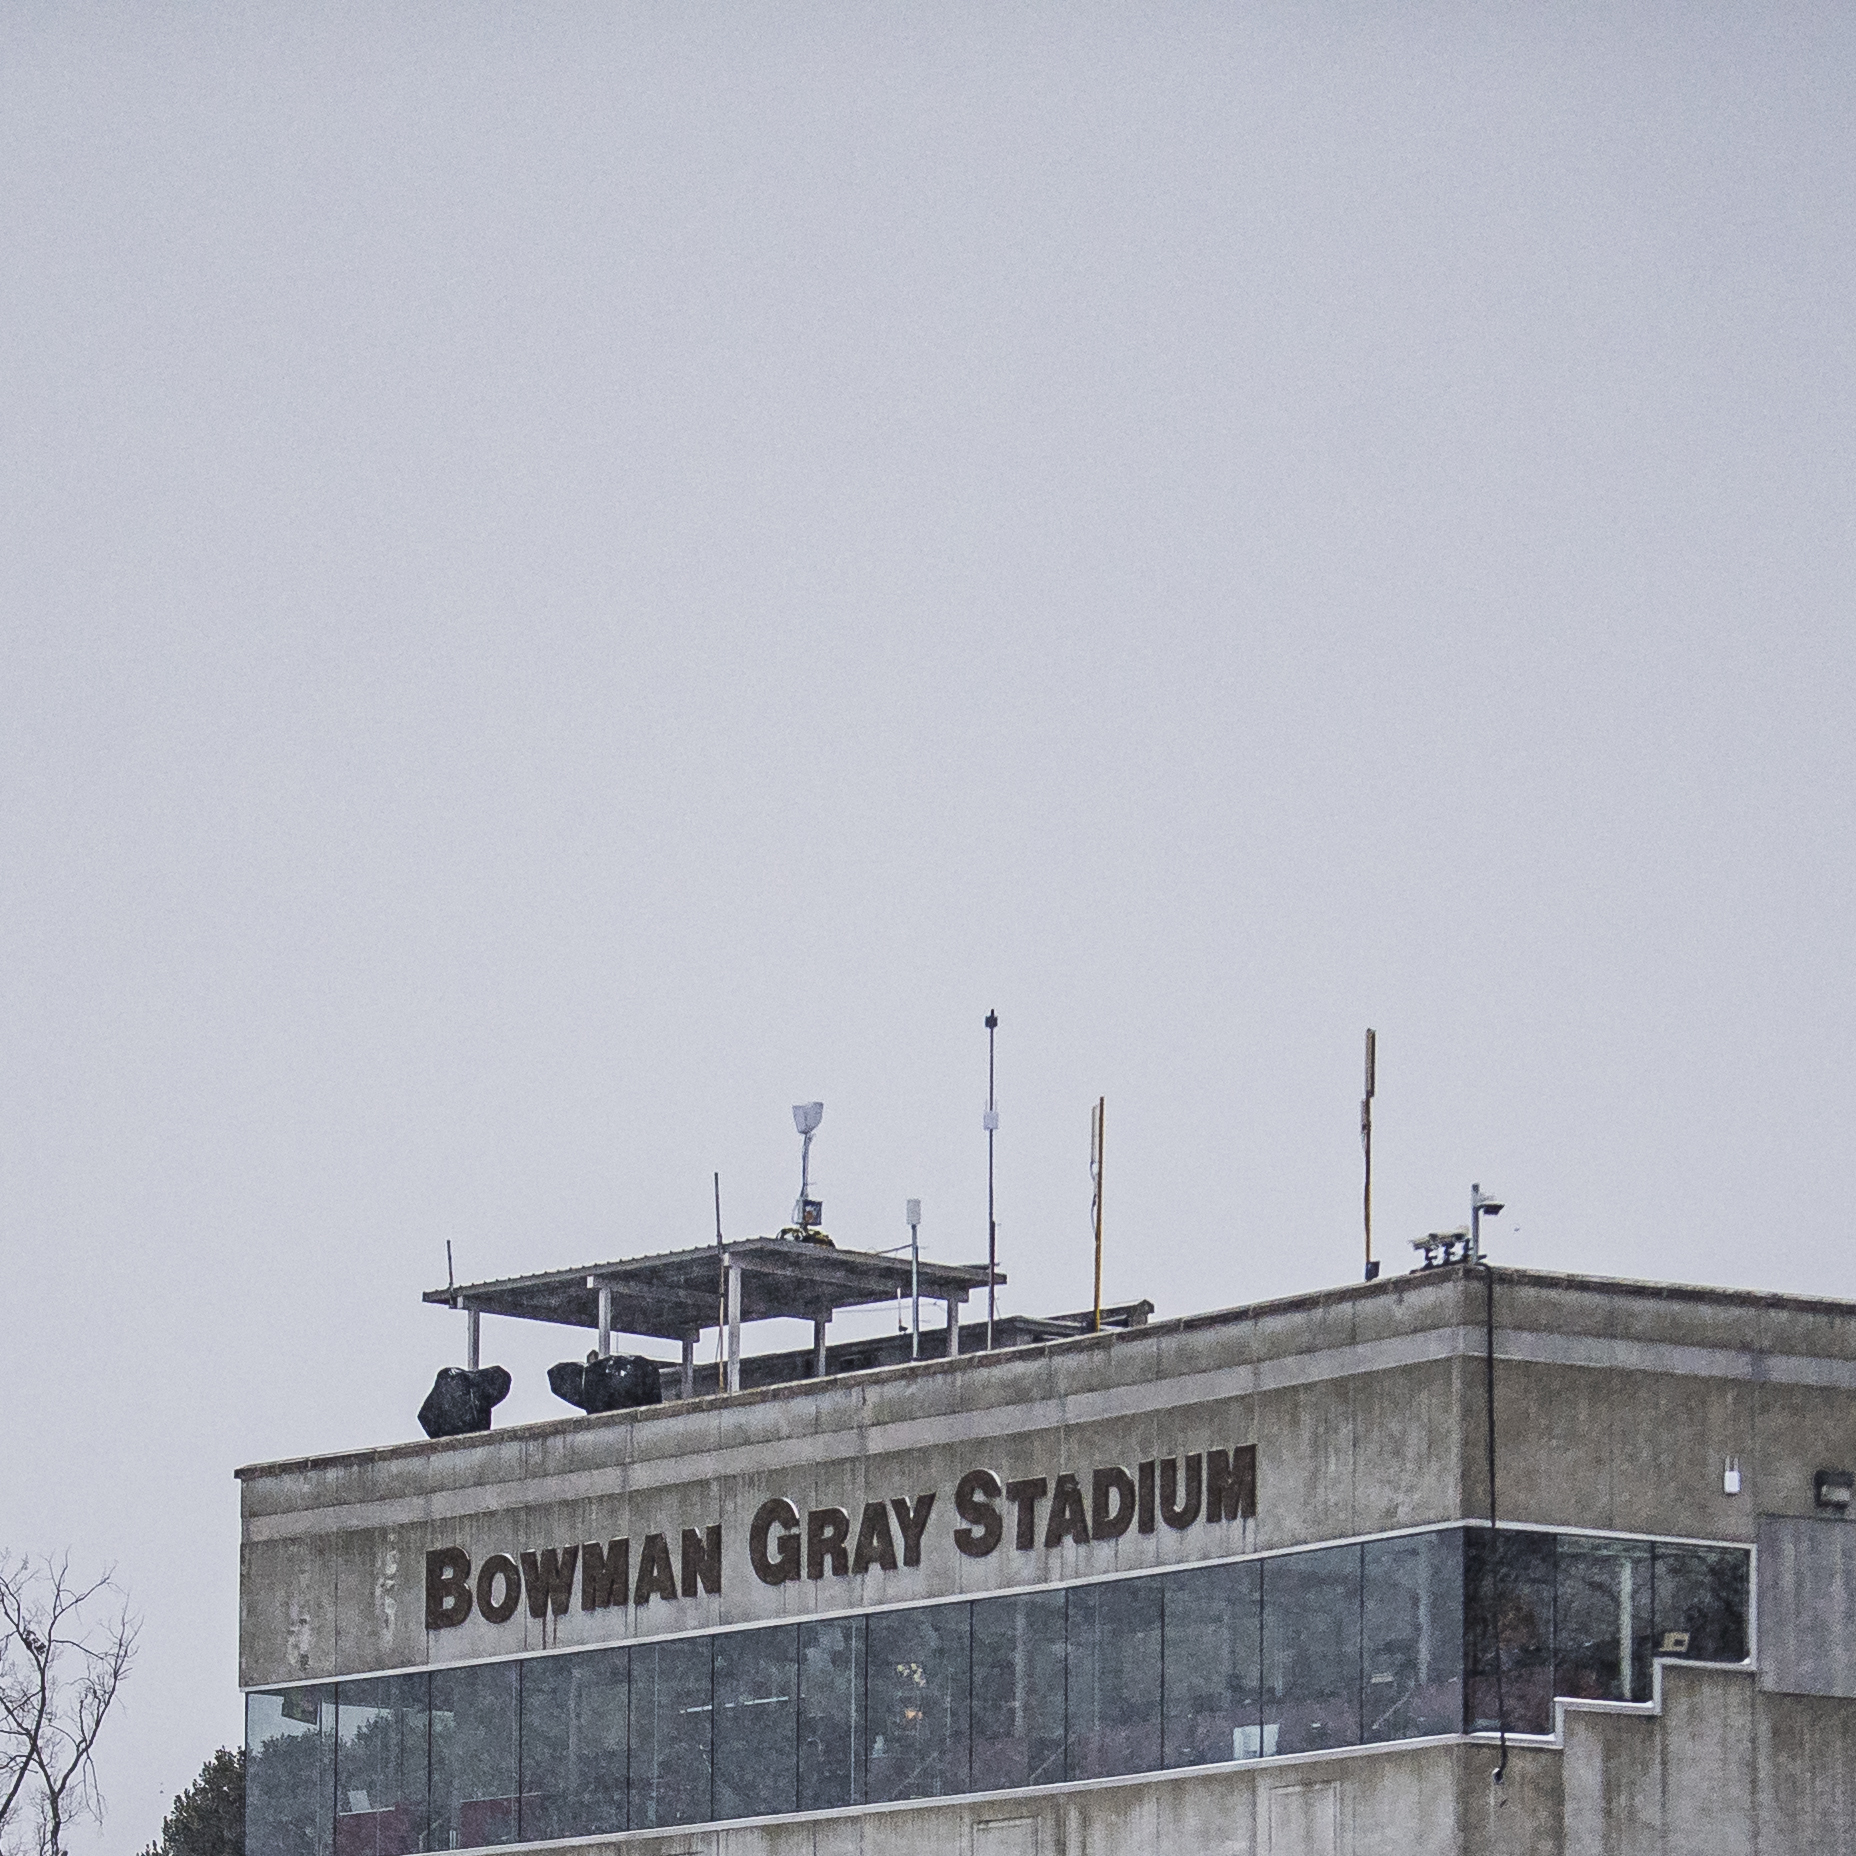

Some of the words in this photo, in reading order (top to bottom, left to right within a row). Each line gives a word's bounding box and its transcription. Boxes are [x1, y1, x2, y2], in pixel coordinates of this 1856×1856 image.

[425, 1524, 722, 1631] BOWMAN
[748, 1492, 937, 1586] GRAY
[952, 1443, 1258, 1558] STADIUM
